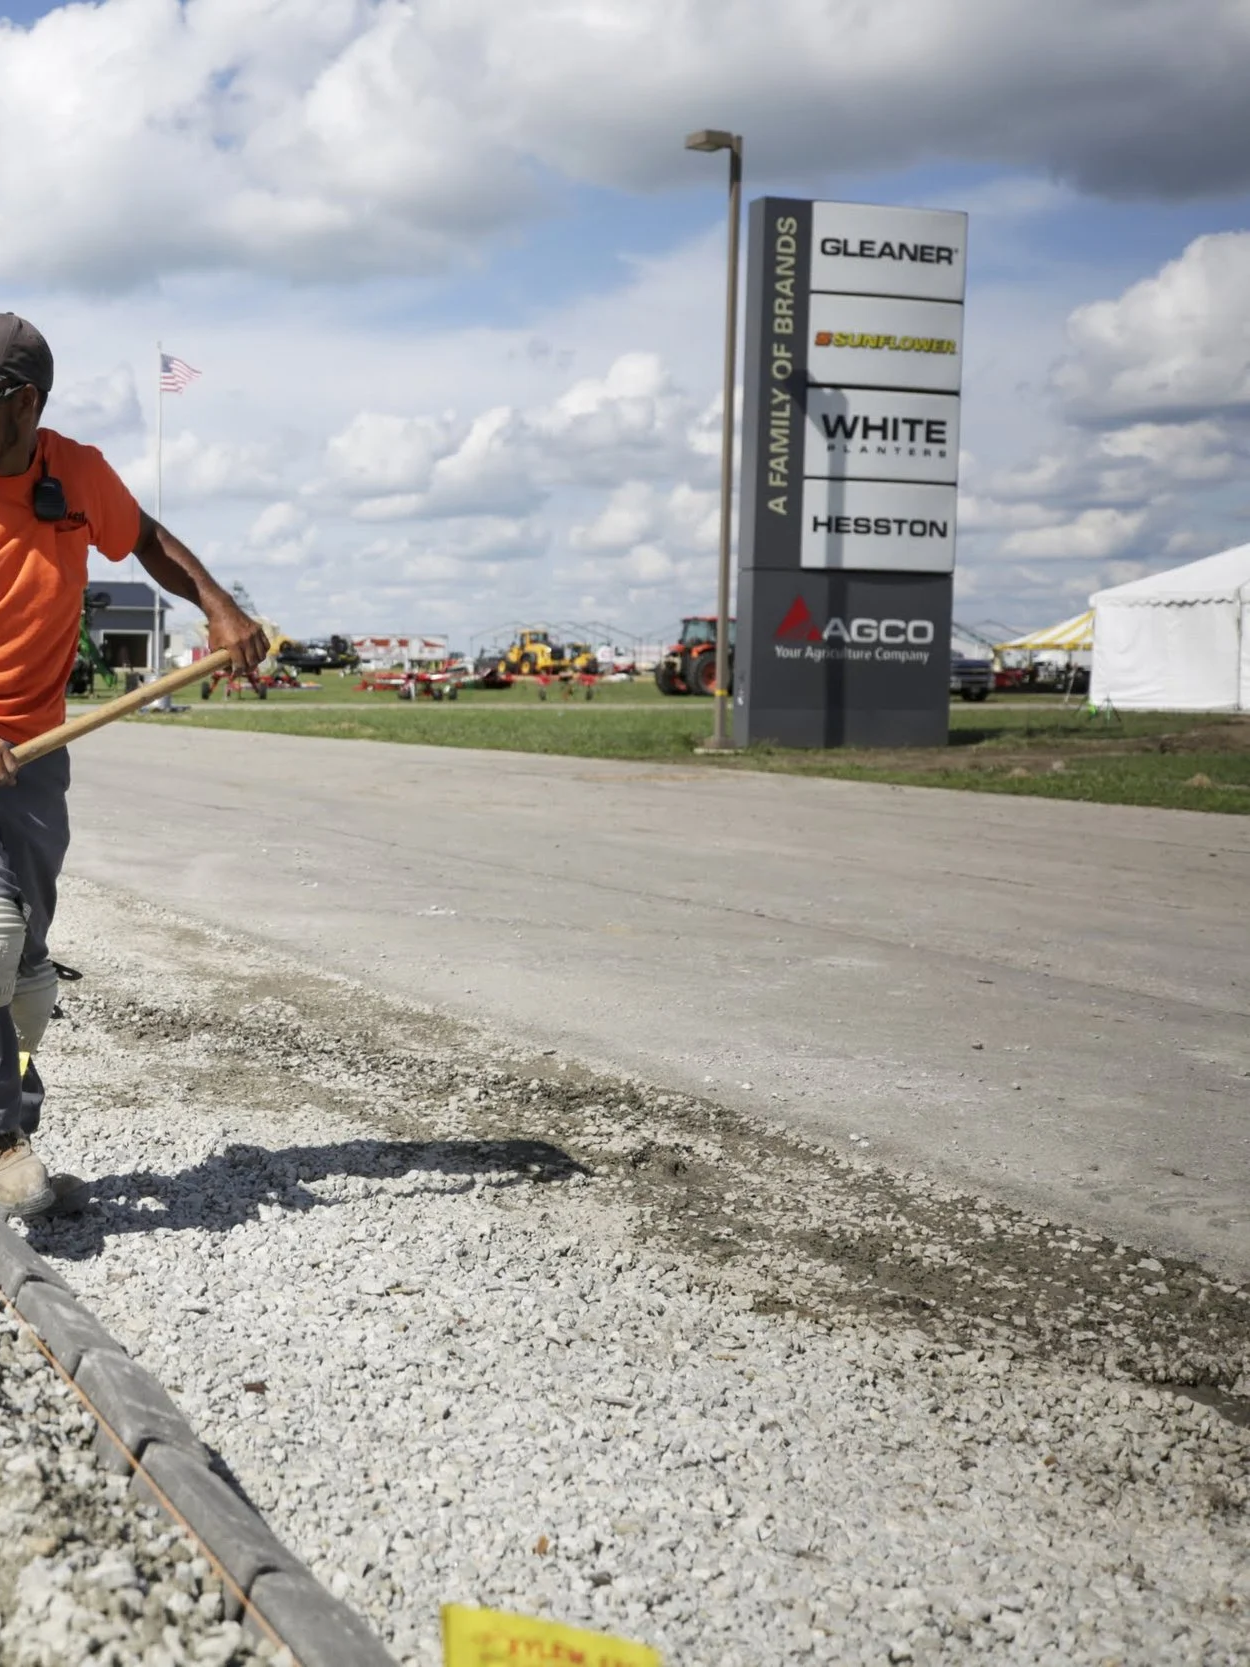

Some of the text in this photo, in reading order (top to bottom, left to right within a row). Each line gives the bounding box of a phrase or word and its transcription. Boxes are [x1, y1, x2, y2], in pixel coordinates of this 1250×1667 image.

[820, 238, 954, 265] GLEANER
[832, 332, 956, 354] SUNFLOWER
[767, 216, 798, 515] A FAMILY OF BRANDS
[821, 413, 948, 445] WHITE
[827, 444, 947, 458] PLANTERS
[812, 515, 948, 538] HESSTON
[822, 617, 935, 644] AGCO
[775, 645, 930, 665] Your Agriculture Company
